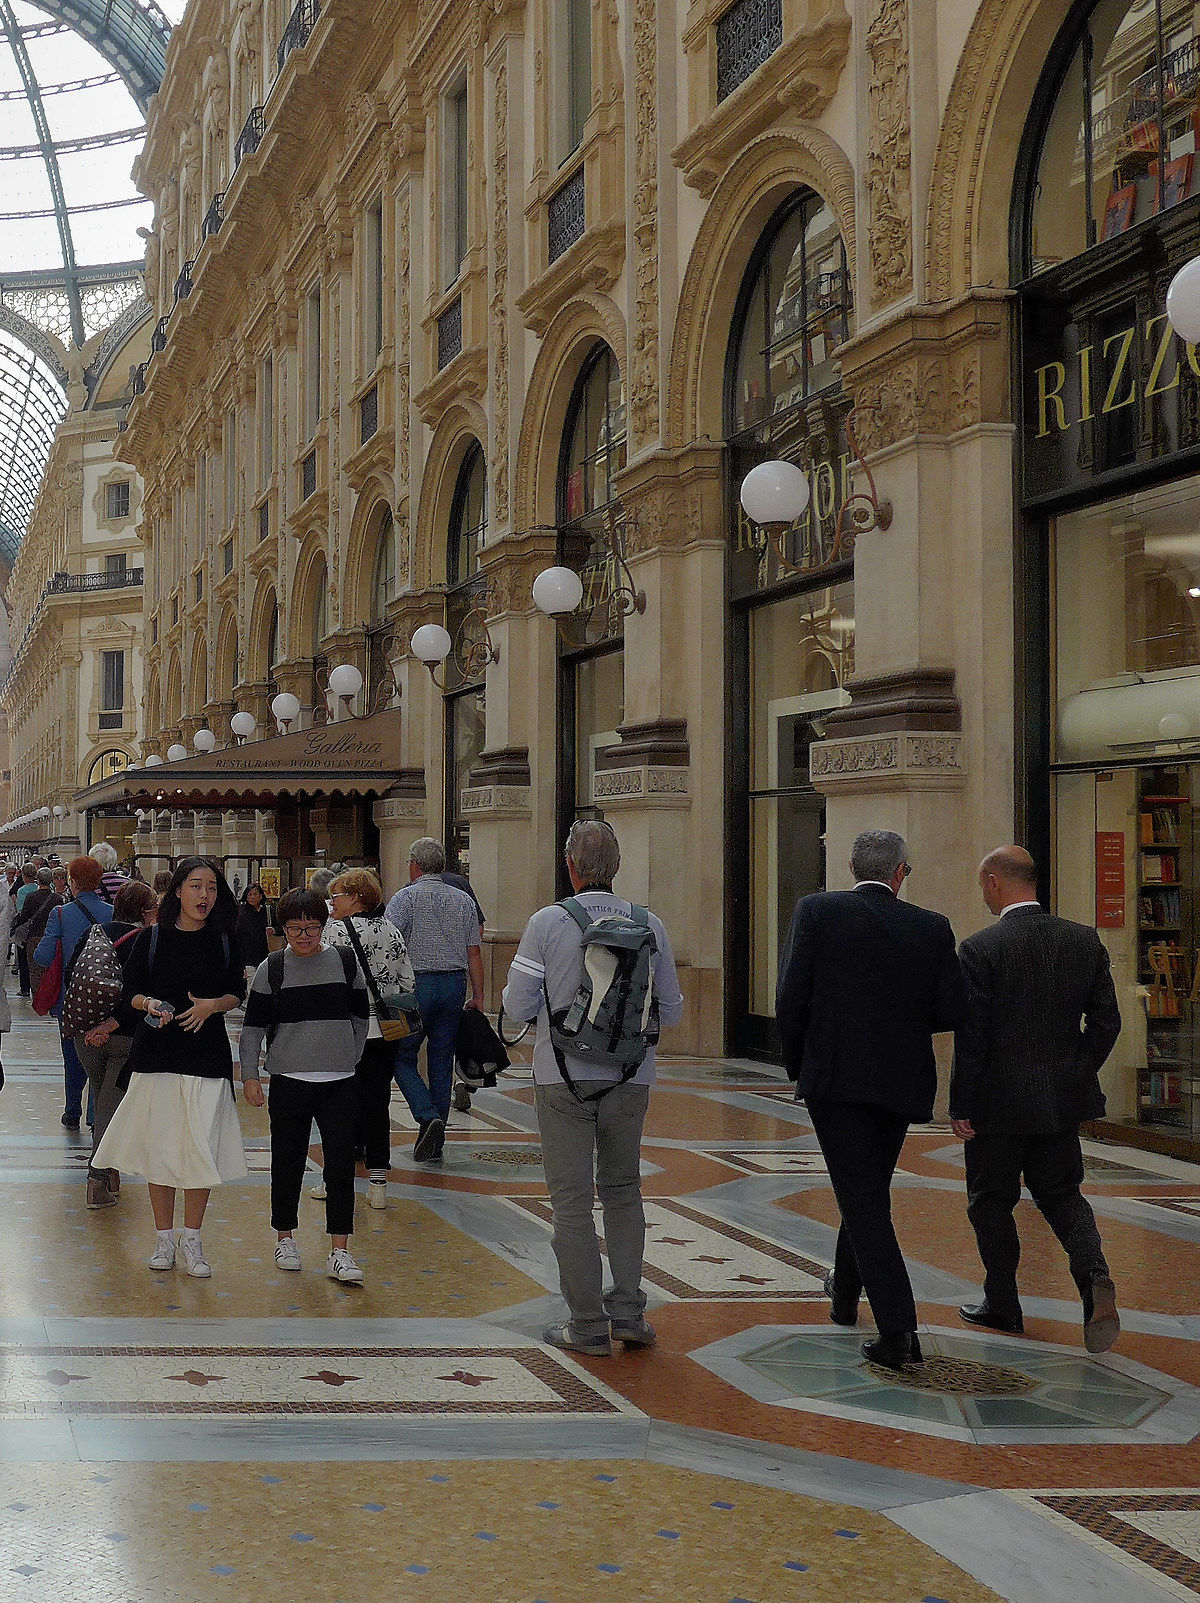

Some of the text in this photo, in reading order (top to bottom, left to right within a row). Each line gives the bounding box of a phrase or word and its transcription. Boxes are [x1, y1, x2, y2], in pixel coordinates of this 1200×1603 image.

[304, 731, 383, 756] Galleria
[215, 759, 384, 769] RESTAURANT WOOD OVEN PIZZA
